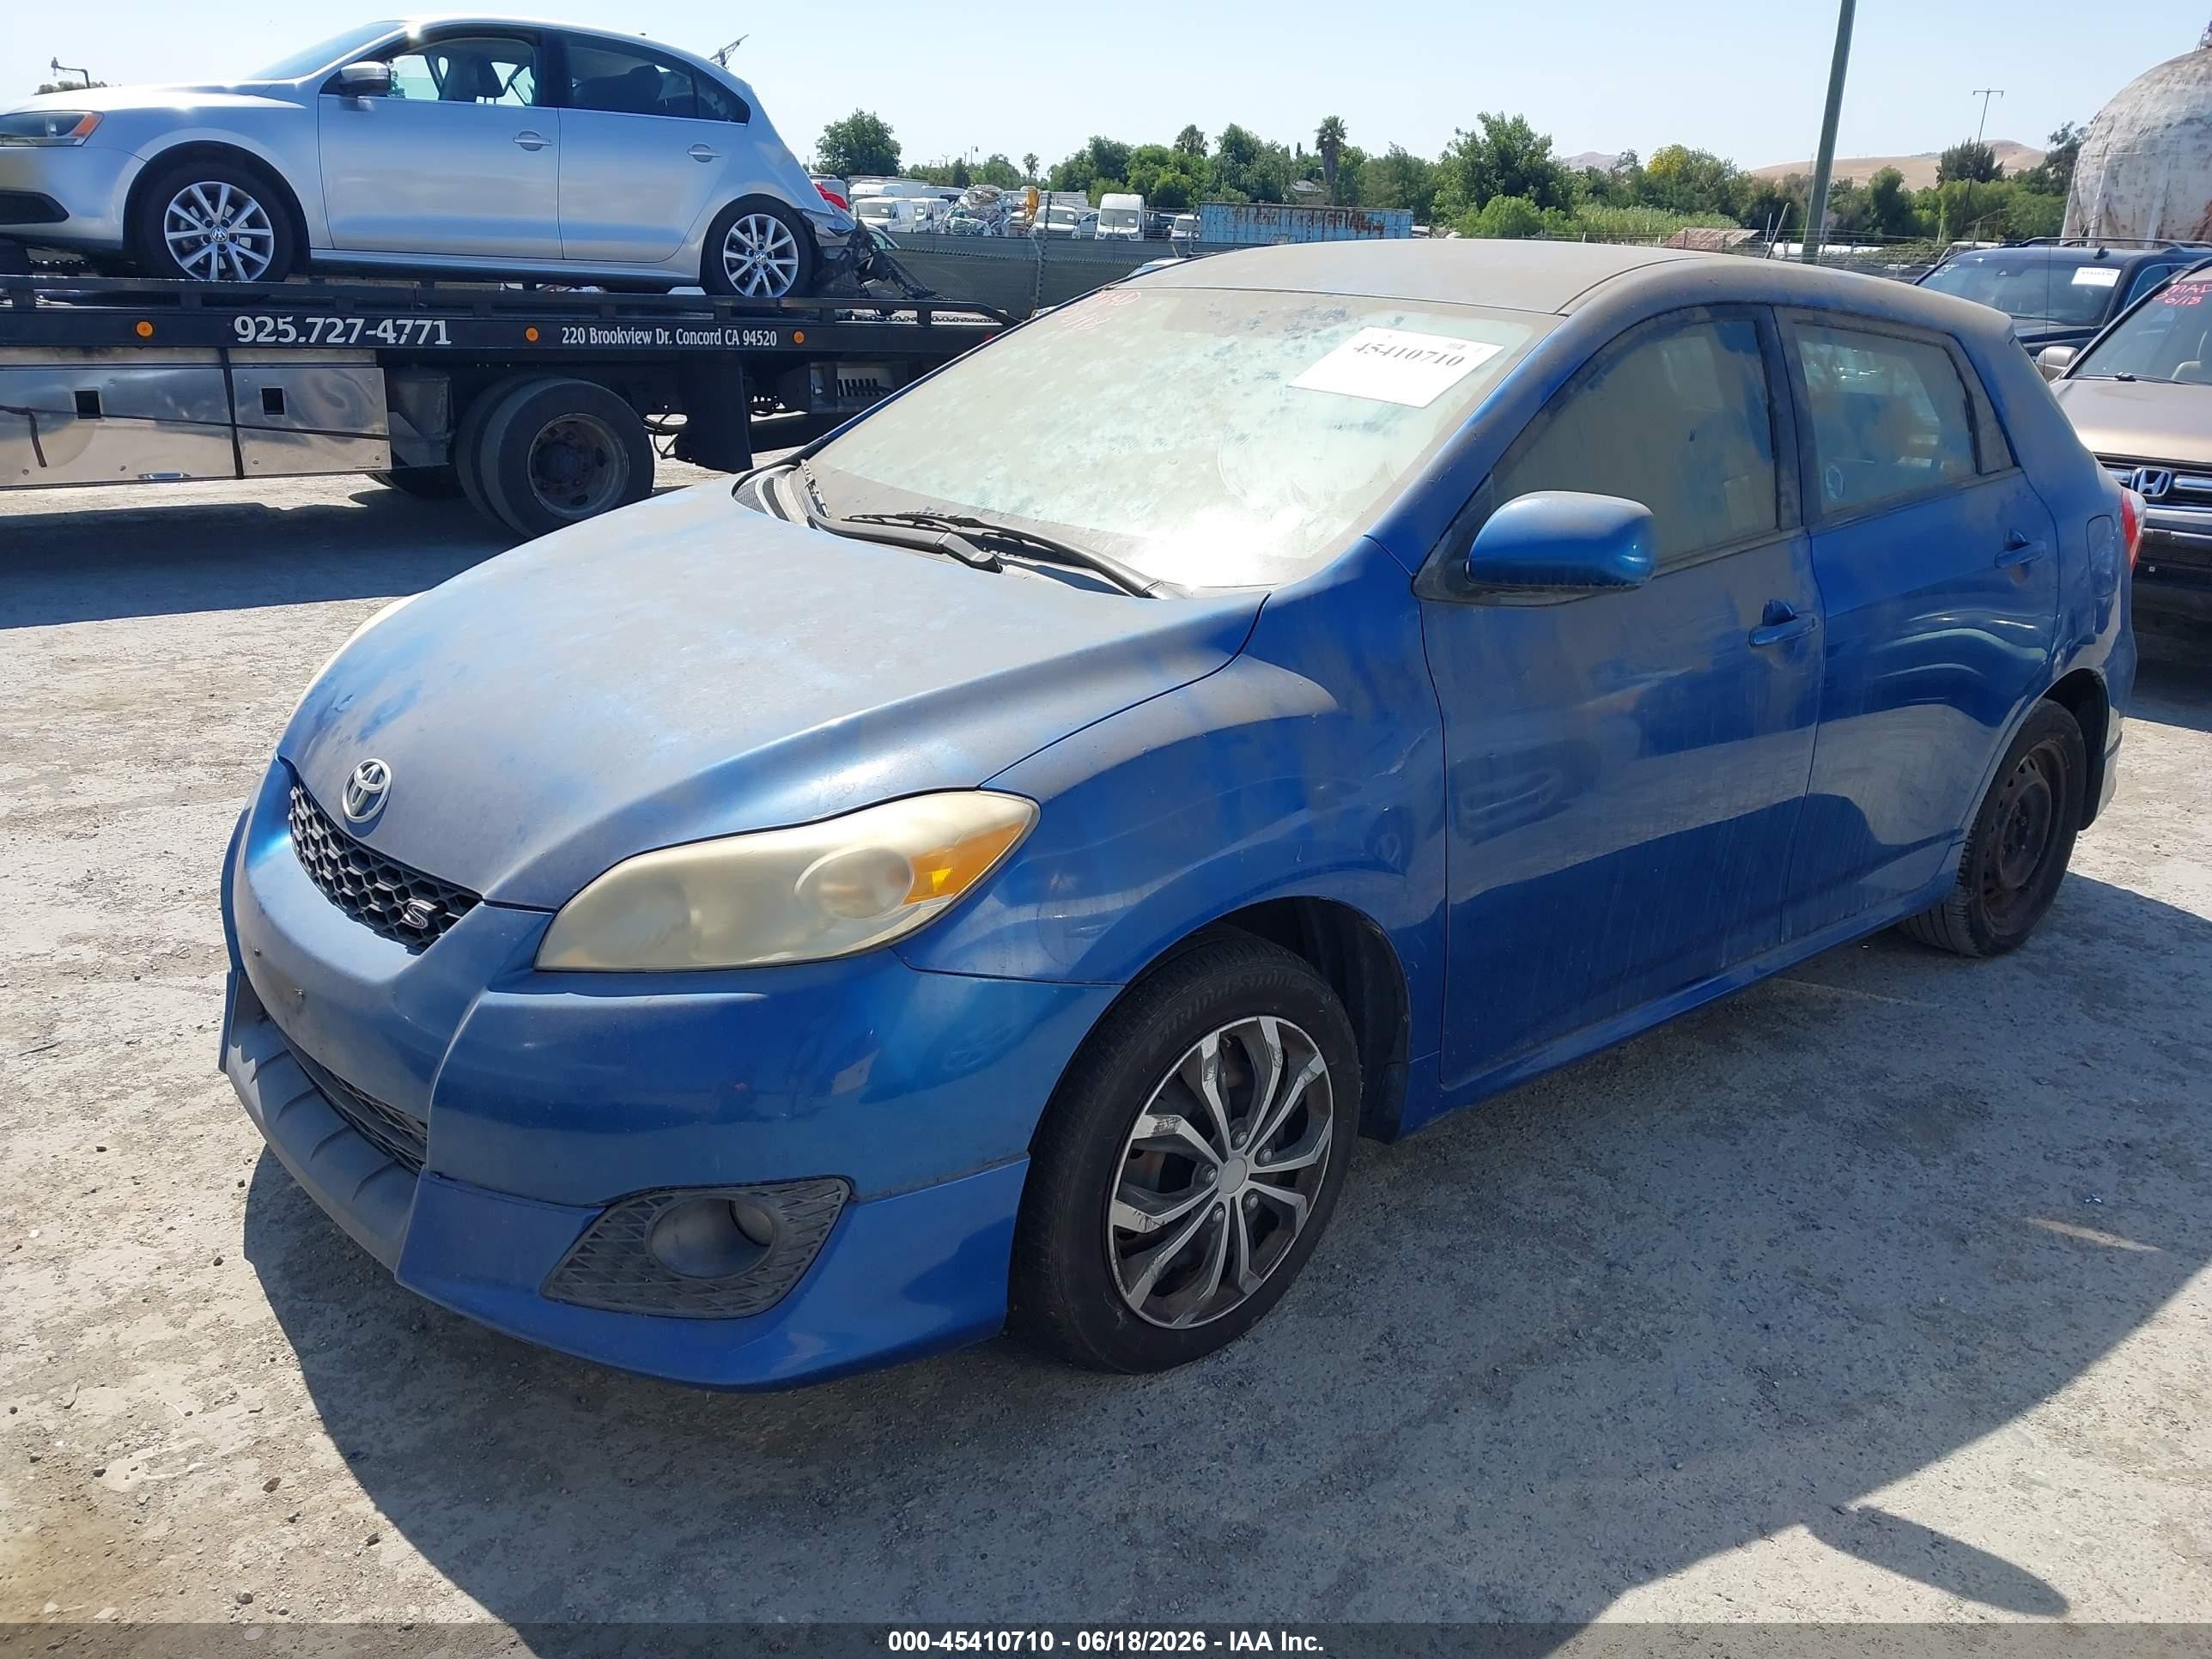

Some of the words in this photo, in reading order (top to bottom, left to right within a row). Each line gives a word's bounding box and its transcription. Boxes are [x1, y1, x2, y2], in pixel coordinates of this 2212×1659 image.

[234, 315, 452, 344] 925.727-4771
[562, 327, 586, 344] 220
[589, 325, 653, 345] Brookview
[655, 328, 672, 345] Dr.
[676, 327, 721, 345] Concord
[725, 329, 740, 346] CA
[743, 330, 777, 347] 94520
[1353, 342, 1466, 368] 45410710
